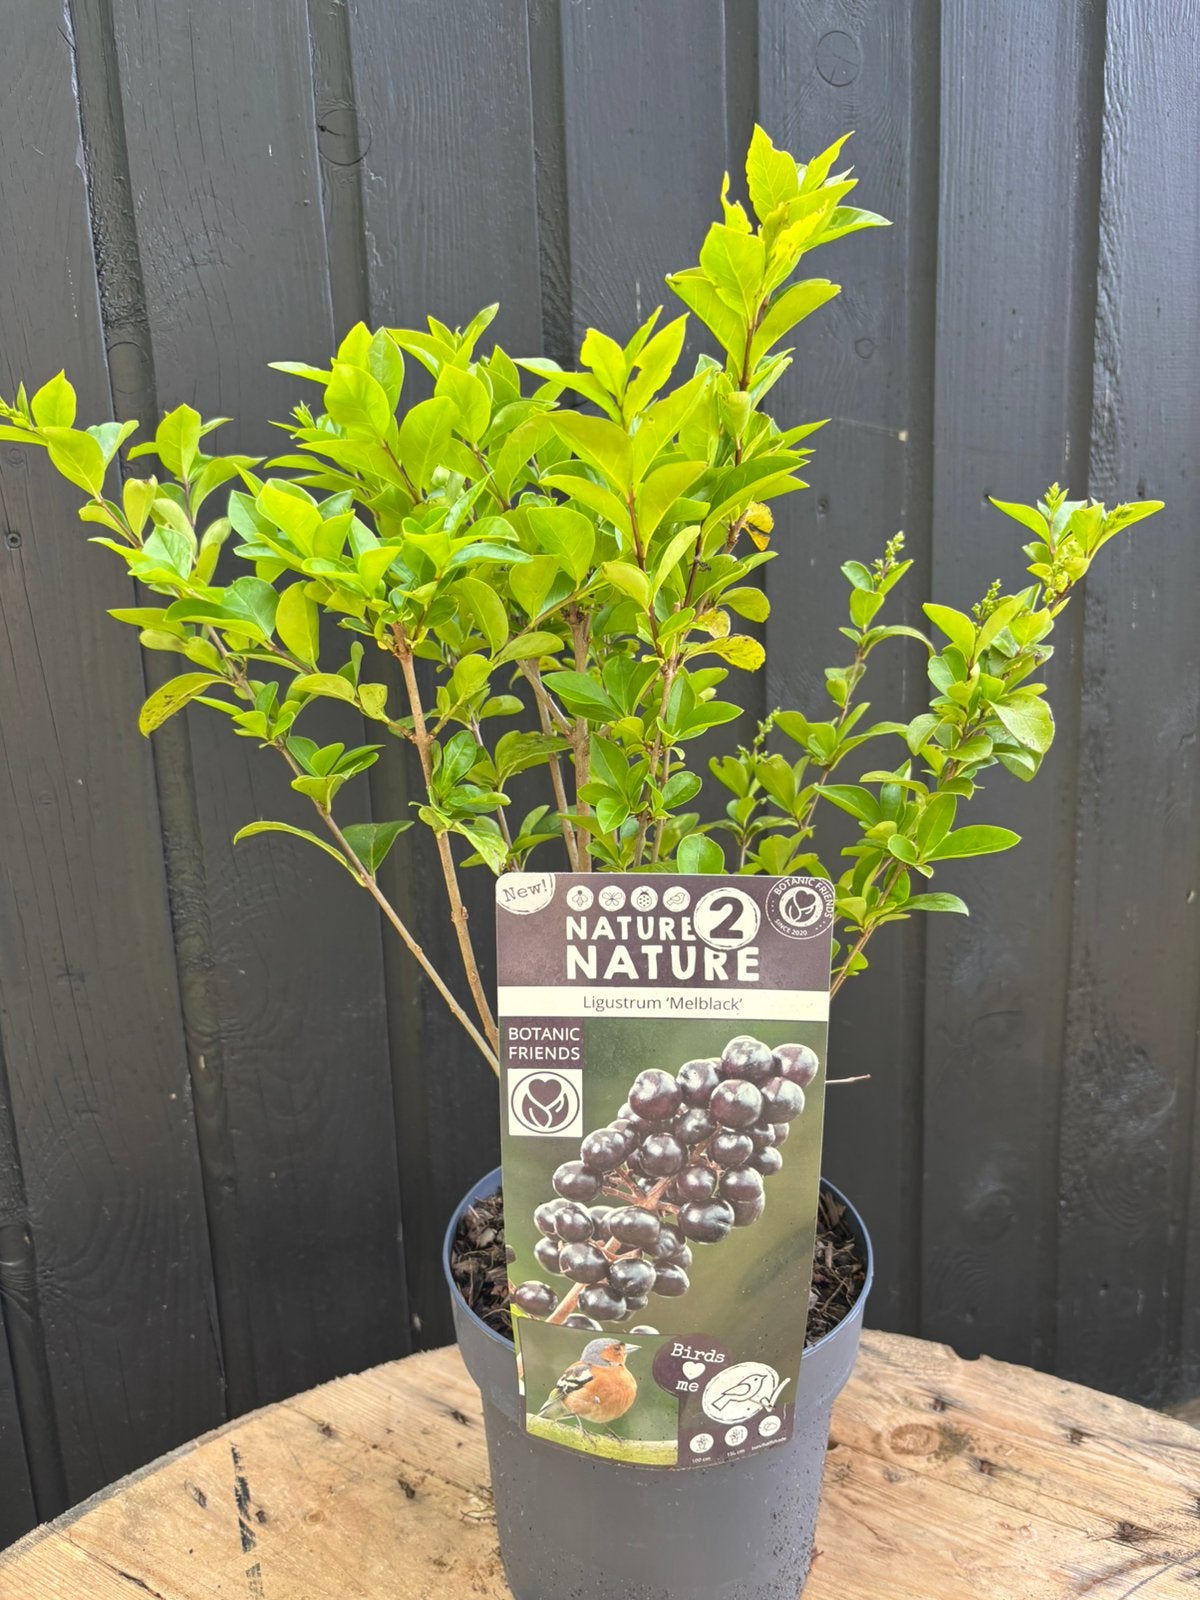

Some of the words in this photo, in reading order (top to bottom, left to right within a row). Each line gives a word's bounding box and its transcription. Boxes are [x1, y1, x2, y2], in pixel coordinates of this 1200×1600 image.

[503, 879, 547, 902] New!
[773, 877, 815, 895] BOTANIC
[815, 882, 833, 919] FRIENDS
[566, 916, 696, 941] NATURE
[709, 900, 744, 939] 2
[774, 918, 791, 933] SINCE
[566, 945, 760, 982] NATURE
[583, 996, 661, 1012] Ligustrum
[508, 1027, 580, 1041] BOTANIC
[508, 1046, 580, 1060] FRIENDS
[671, 1342, 725, 1363] Birds
[675, 1380, 699, 1392] me
